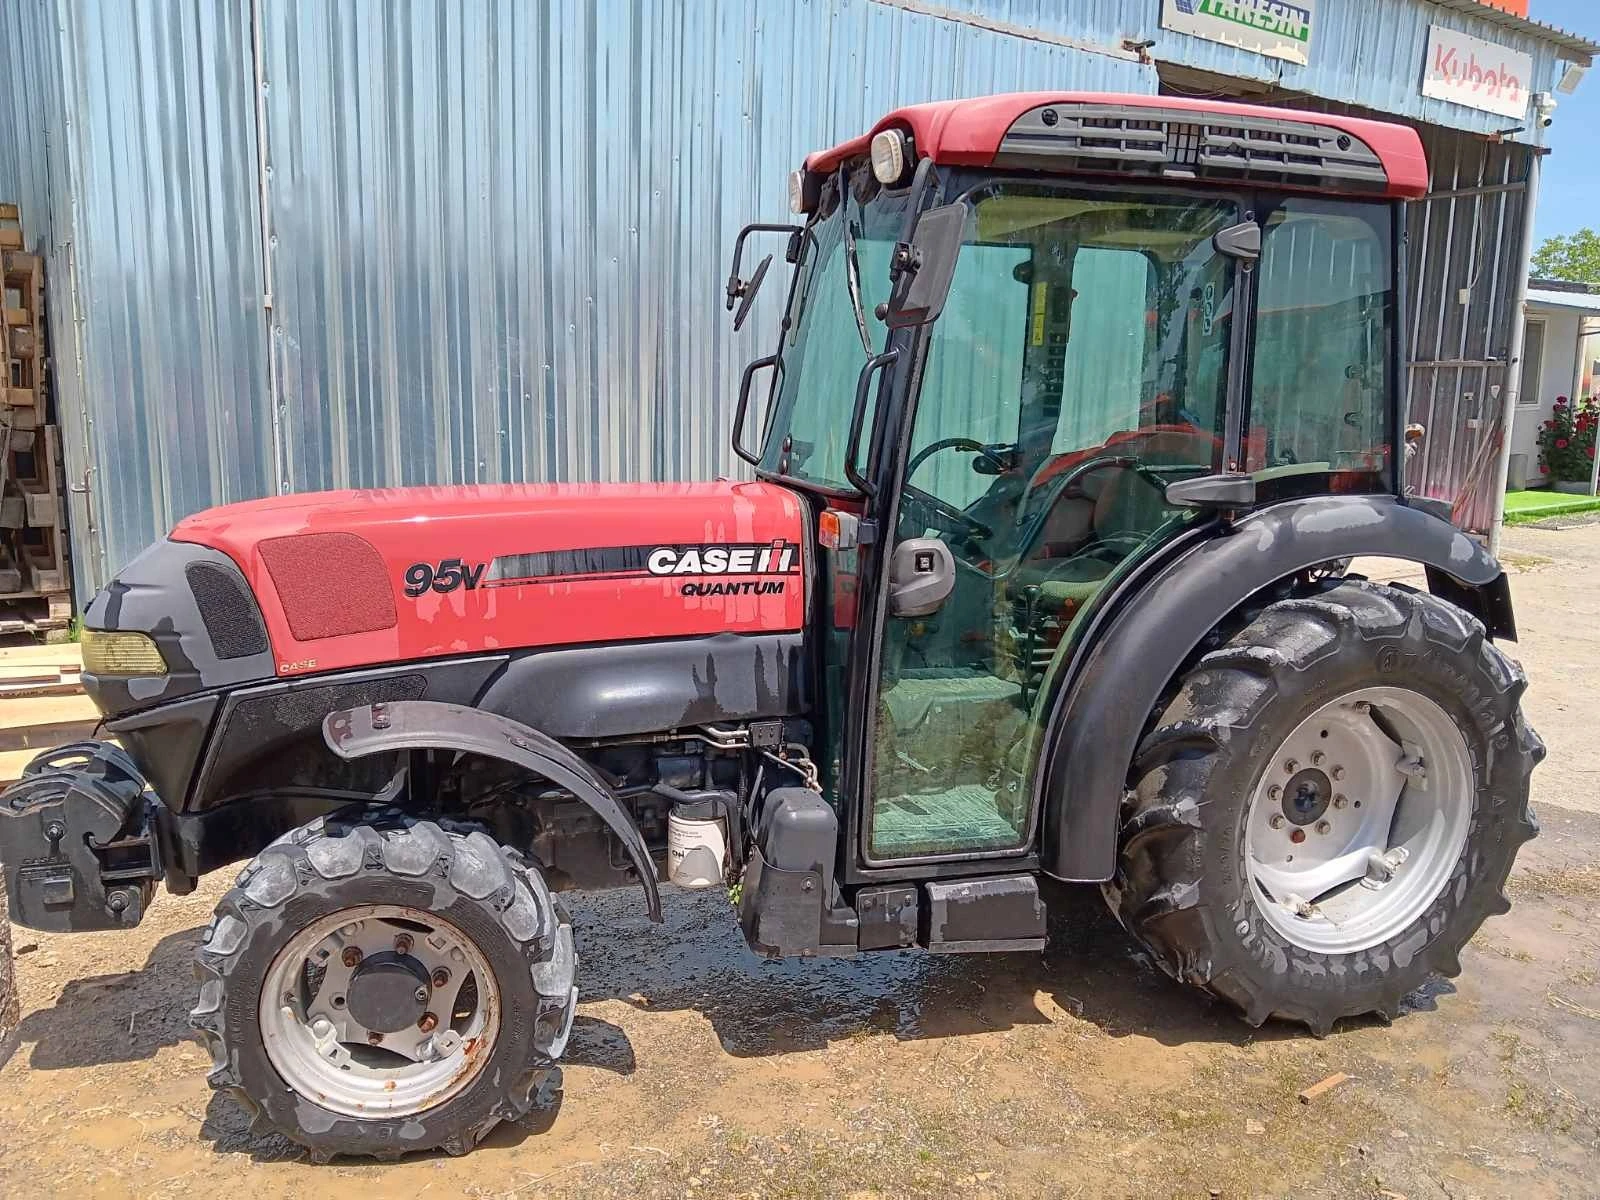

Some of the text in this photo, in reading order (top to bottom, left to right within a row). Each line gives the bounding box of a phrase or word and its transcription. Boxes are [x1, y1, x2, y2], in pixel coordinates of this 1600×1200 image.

[1434, 44, 1520, 101] Kubota
[648, 549, 755, 574] CASE
[681, 582, 785, 597] QUANTUM
[280, 660, 316, 672] CASE
